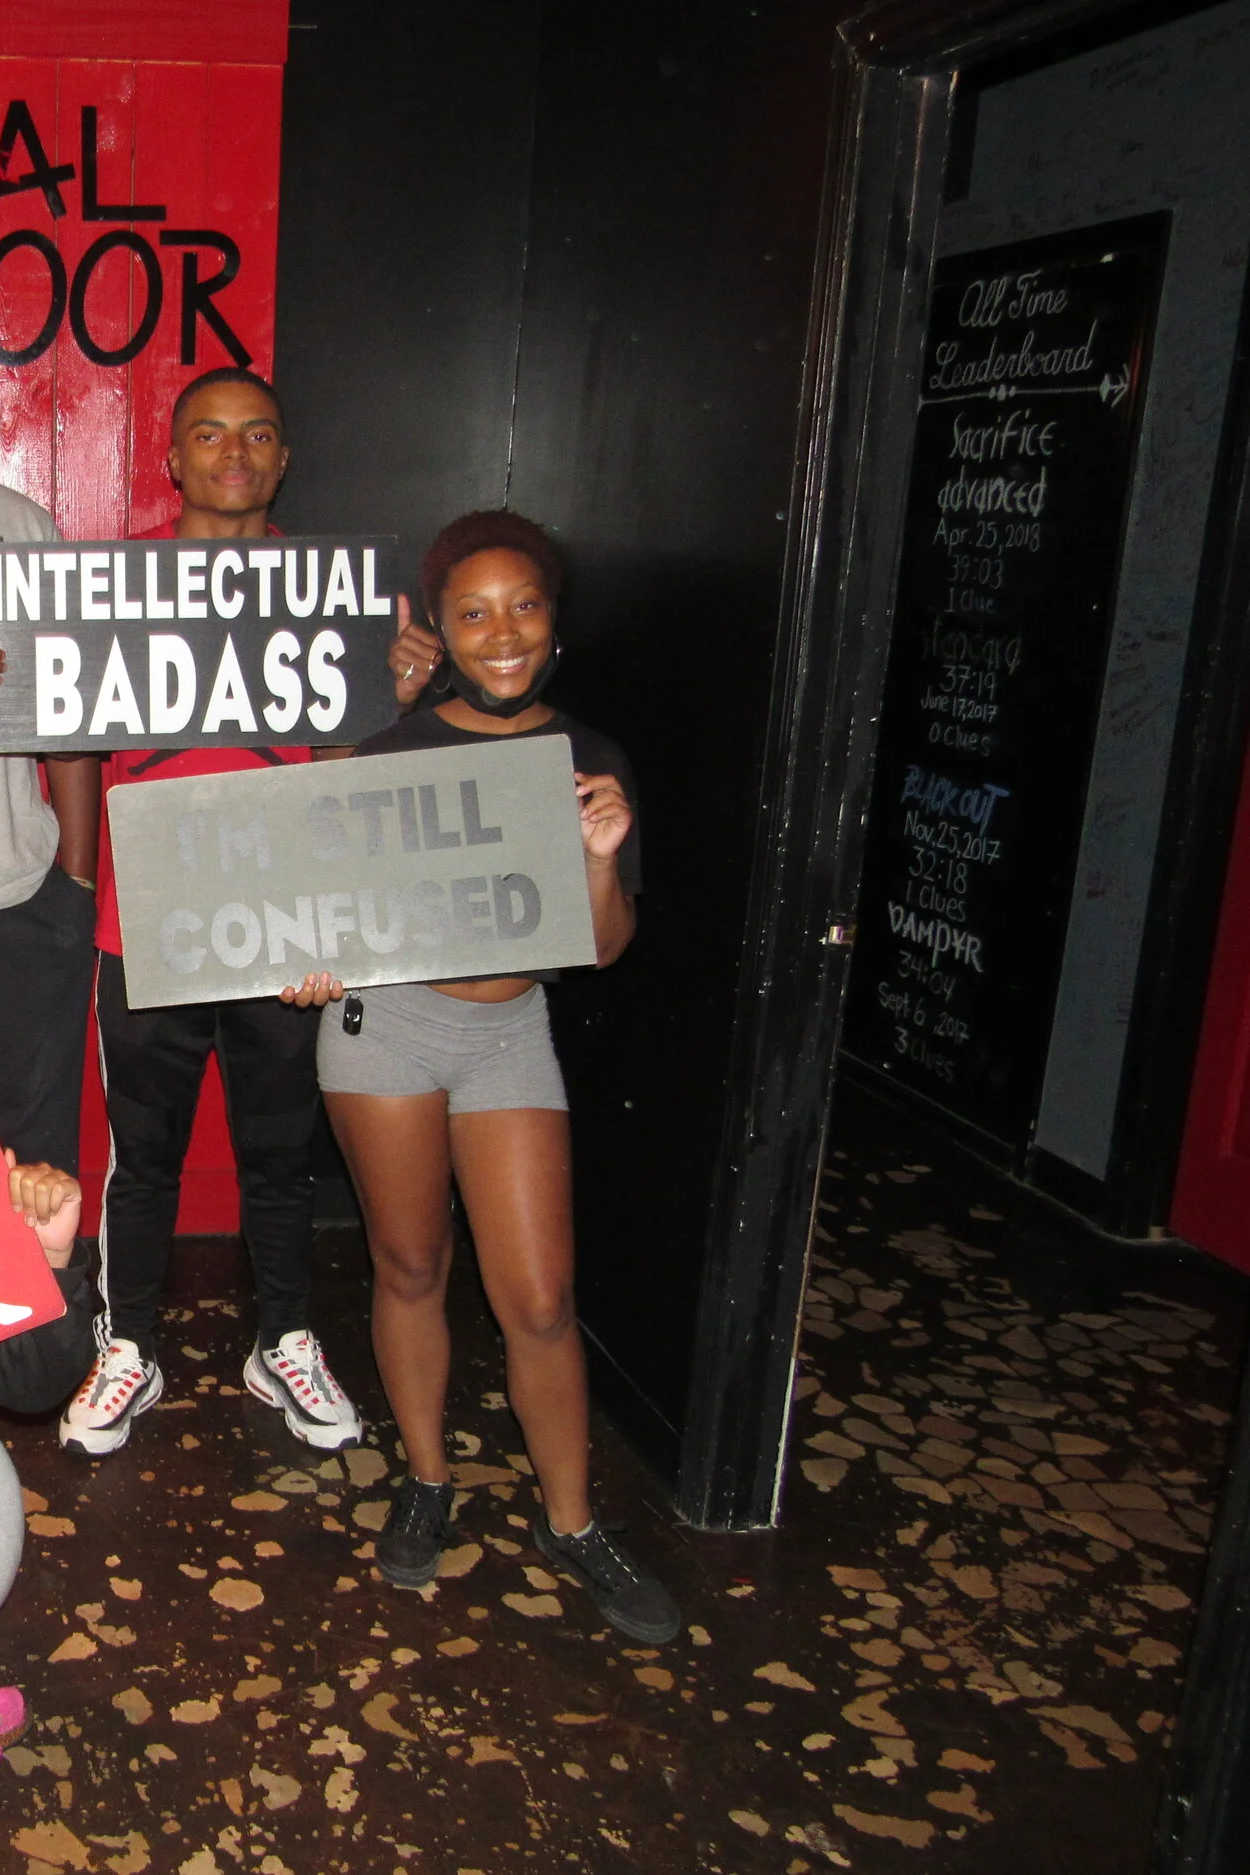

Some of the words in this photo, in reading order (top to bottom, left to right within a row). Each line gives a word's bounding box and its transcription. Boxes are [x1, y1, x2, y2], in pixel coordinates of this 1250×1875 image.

[958, 276, 1012, 327] All
[1008, 269, 1069, 319] Time
[929, 318, 1100, 390] Leaderboard
[948, 409, 1058, 463] Sacrifice
[937, 464, 1048, 518] advanced
[35, 630, 348, 736] BADASS
[920, 685, 950, 713] June
[939, 664, 998, 700] 37:19
[943, 724, 991, 757] Clues
[305, 779, 503, 863] STILL
[907, 845, 969, 895] 32:18
[158, 872, 542, 974] CONFUSED
[918, 884, 967, 923] Clues
[897, 949, 958, 1005] 34:04
[894, 1024, 909, 1054] 3
